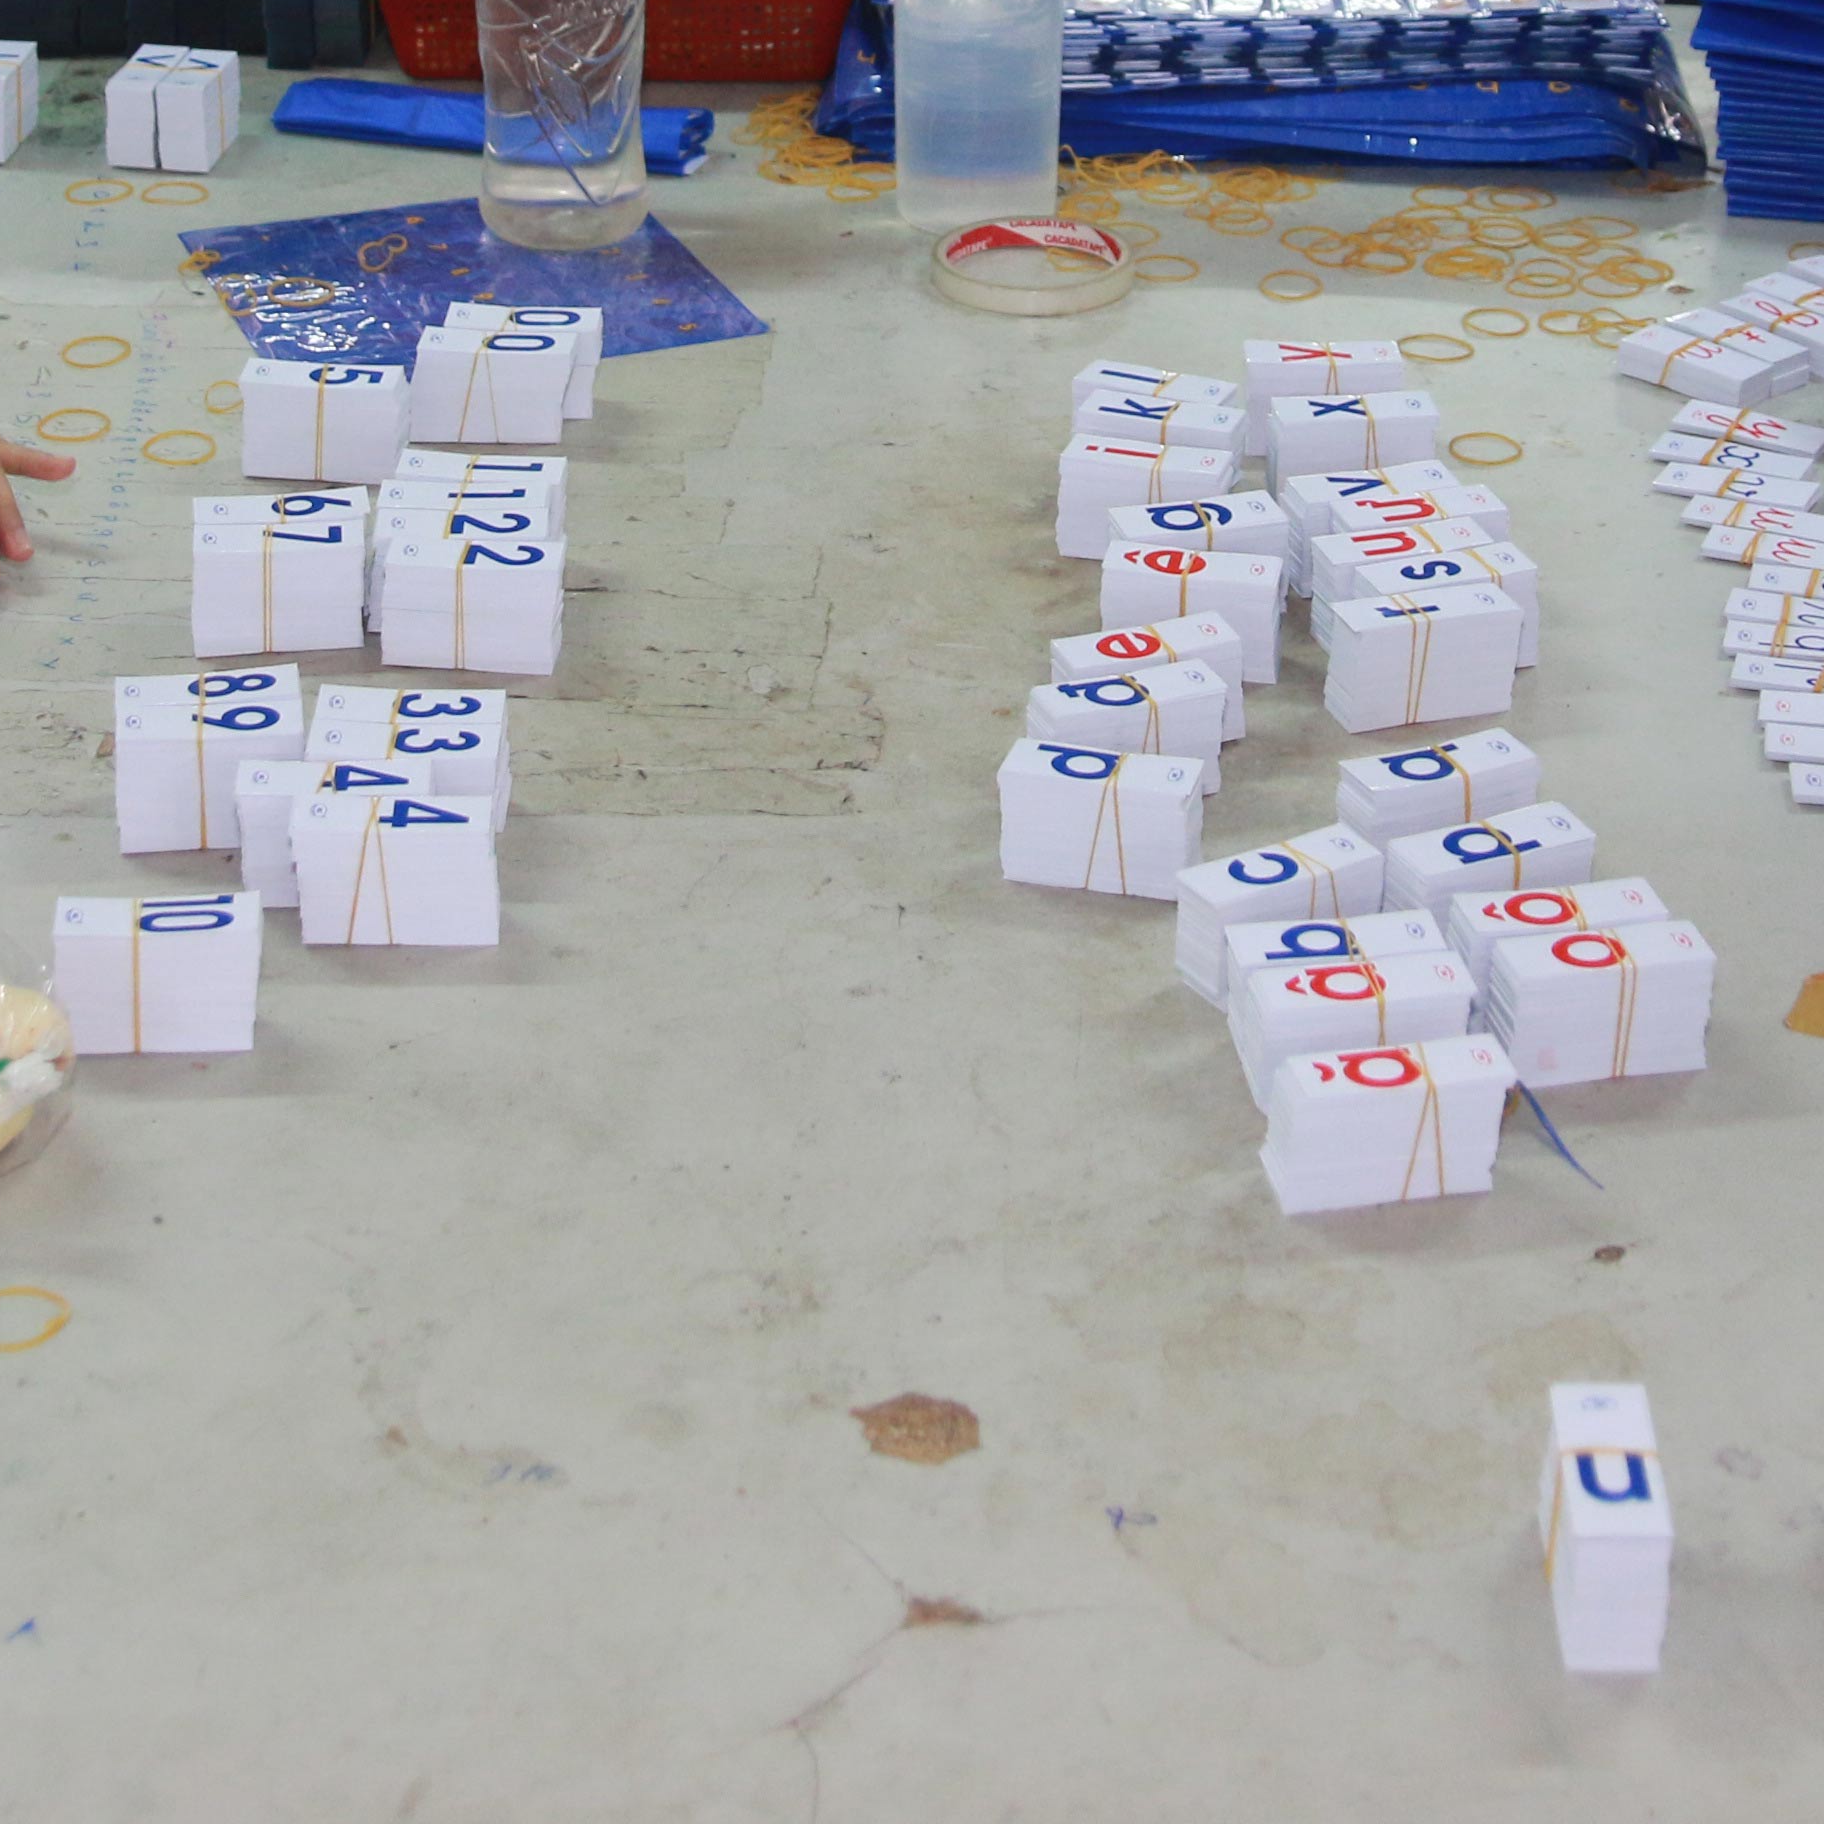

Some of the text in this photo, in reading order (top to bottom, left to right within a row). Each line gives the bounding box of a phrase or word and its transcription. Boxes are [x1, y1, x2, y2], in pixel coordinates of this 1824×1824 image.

[510, 308, 580, 328] 0
[484, 334, 555, 352] 0
[1278, 344, 1352, 362] y
[309, 366, 384, 386] 5
[1098, 398, 1179, 420] k
[1307, 398, 1366, 417] x
[1085, 444, 1159, 458] i
[1717, 445, 1760, 468] x
[467, 462, 543, 472] 1
[448, 487, 526, 498] 1
[1325, 476, 1385, 496] v
[271, 495, 352, 517] 6
[1146, 501, 1232, 532] g
[263, 526, 342, 543] 7
[450, 511, 530, 536] 2
[462, 544, 544, 566] 2
[1350, 530, 1418, 557] u
[1124, 549, 1207, 576] ê
[1399, 559, 1463, 581] s
[1095, 631, 1162, 660] e
[187, 674, 276, 697] 8
[1057, 675, 1149, 707] đ
[394, 693, 482, 718] 3
[192, 706, 280, 731] 9
[393, 728, 481, 753] 3
[1037, 743, 1121, 780] d
[322, 765, 410, 791] 4
[379, 799, 470, 828] 4
[1441, 823, 1541, 865] p
[1227, 851, 1299, 885] c
[138, 893, 234, 933] 10
[1483, 891, 1576, 925] ô
[1265, 922, 1361, 960] b
[1551, 934, 1629, 969] o
[1285, 962, 1387, 1002] â
[1312, 1047, 1424, 1089] ă
